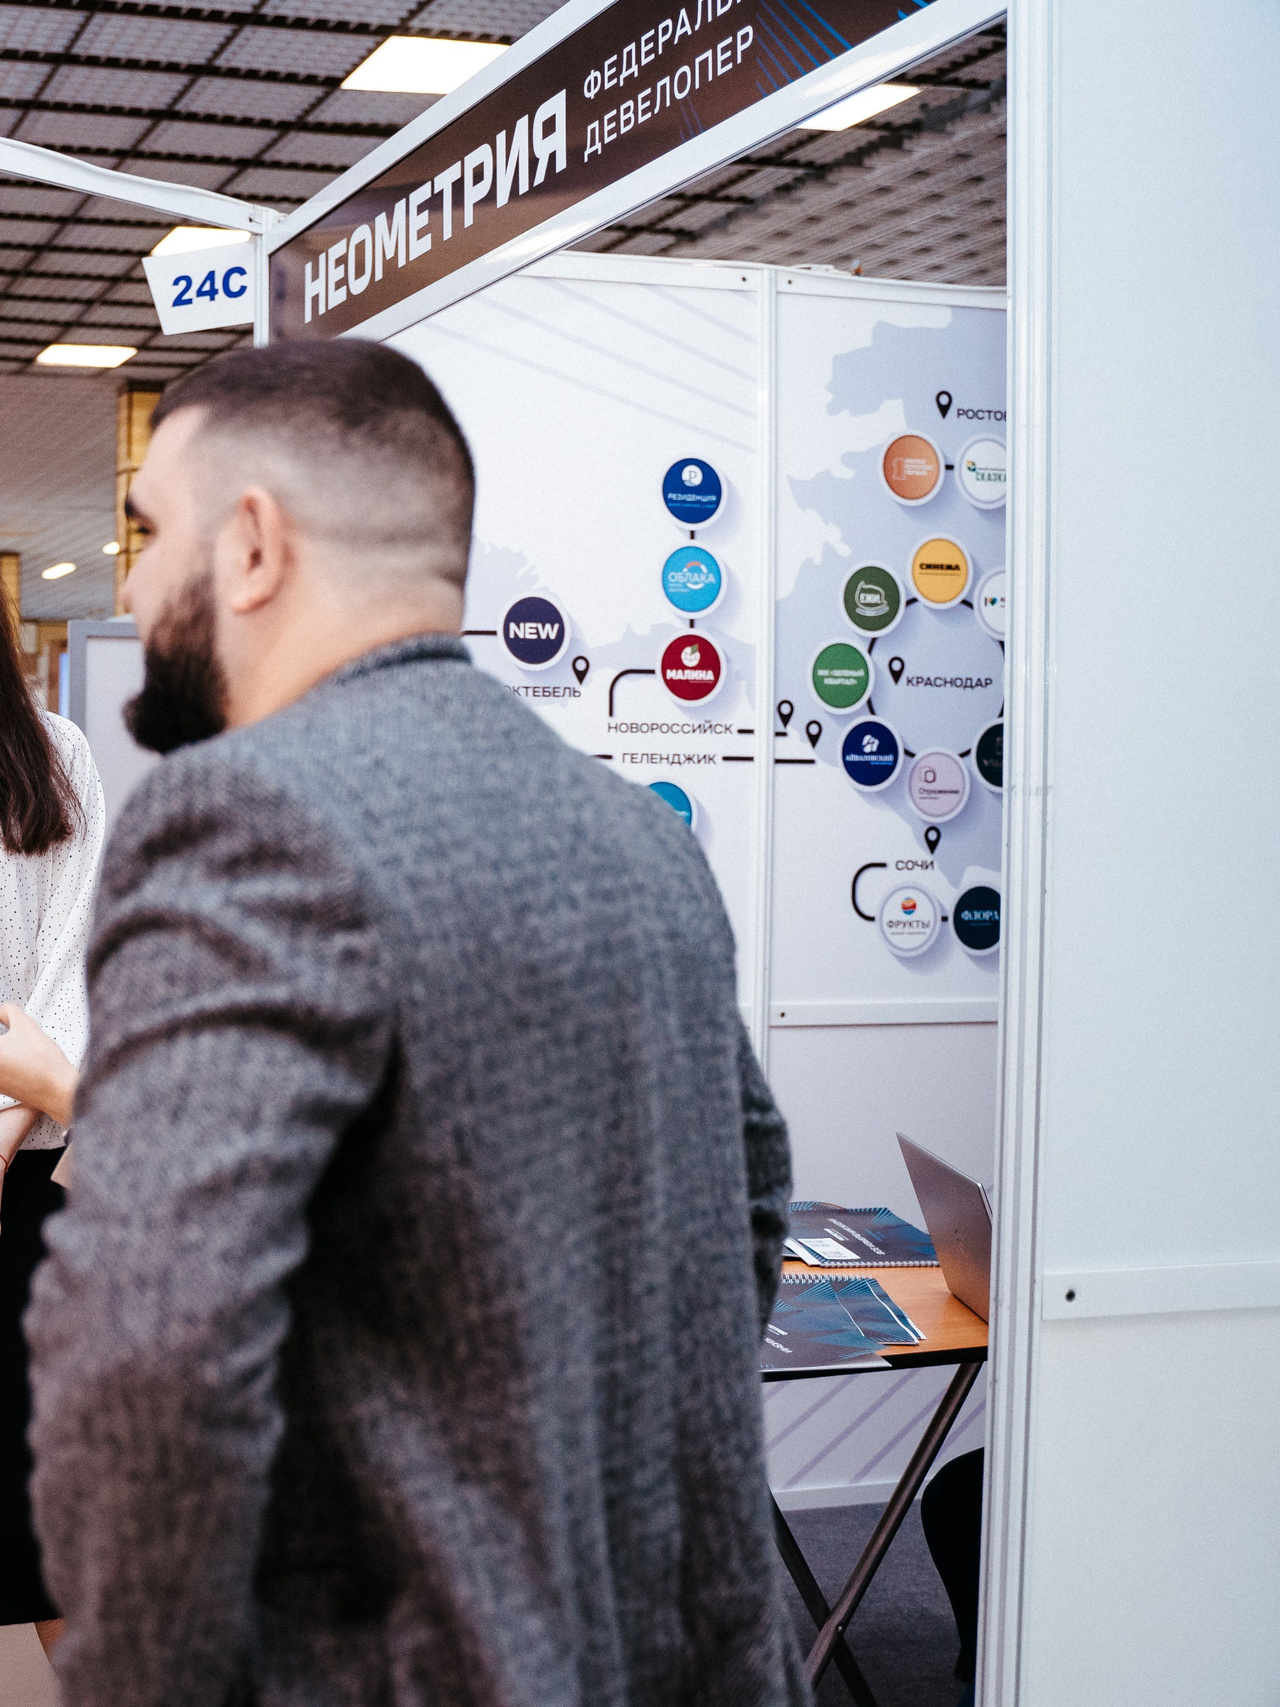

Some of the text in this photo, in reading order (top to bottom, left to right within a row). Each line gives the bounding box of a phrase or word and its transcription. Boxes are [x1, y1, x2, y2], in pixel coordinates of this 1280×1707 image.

[583, 25, 754, 164] ДЕВЕЛОПЕР
[304, 90, 568, 324] НЕОМЕТРИЯ
[171, 266, 248, 308] 24C
[667, 571, 716, 584] ОБЛАКА
[508, 622, 559, 640] NEW
[666, 669, 715, 681] МАЛИНА
[906, 676, 993, 690] КРАСНОДАР
[607, 720, 733, 734] НОВОРОССИЙСК
[622, 753, 716, 766] ГЕЛЕНДЖИК
[895, 860, 935, 871] СОЧИ
[886, 920, 930, 930] ФРУКТЫ
